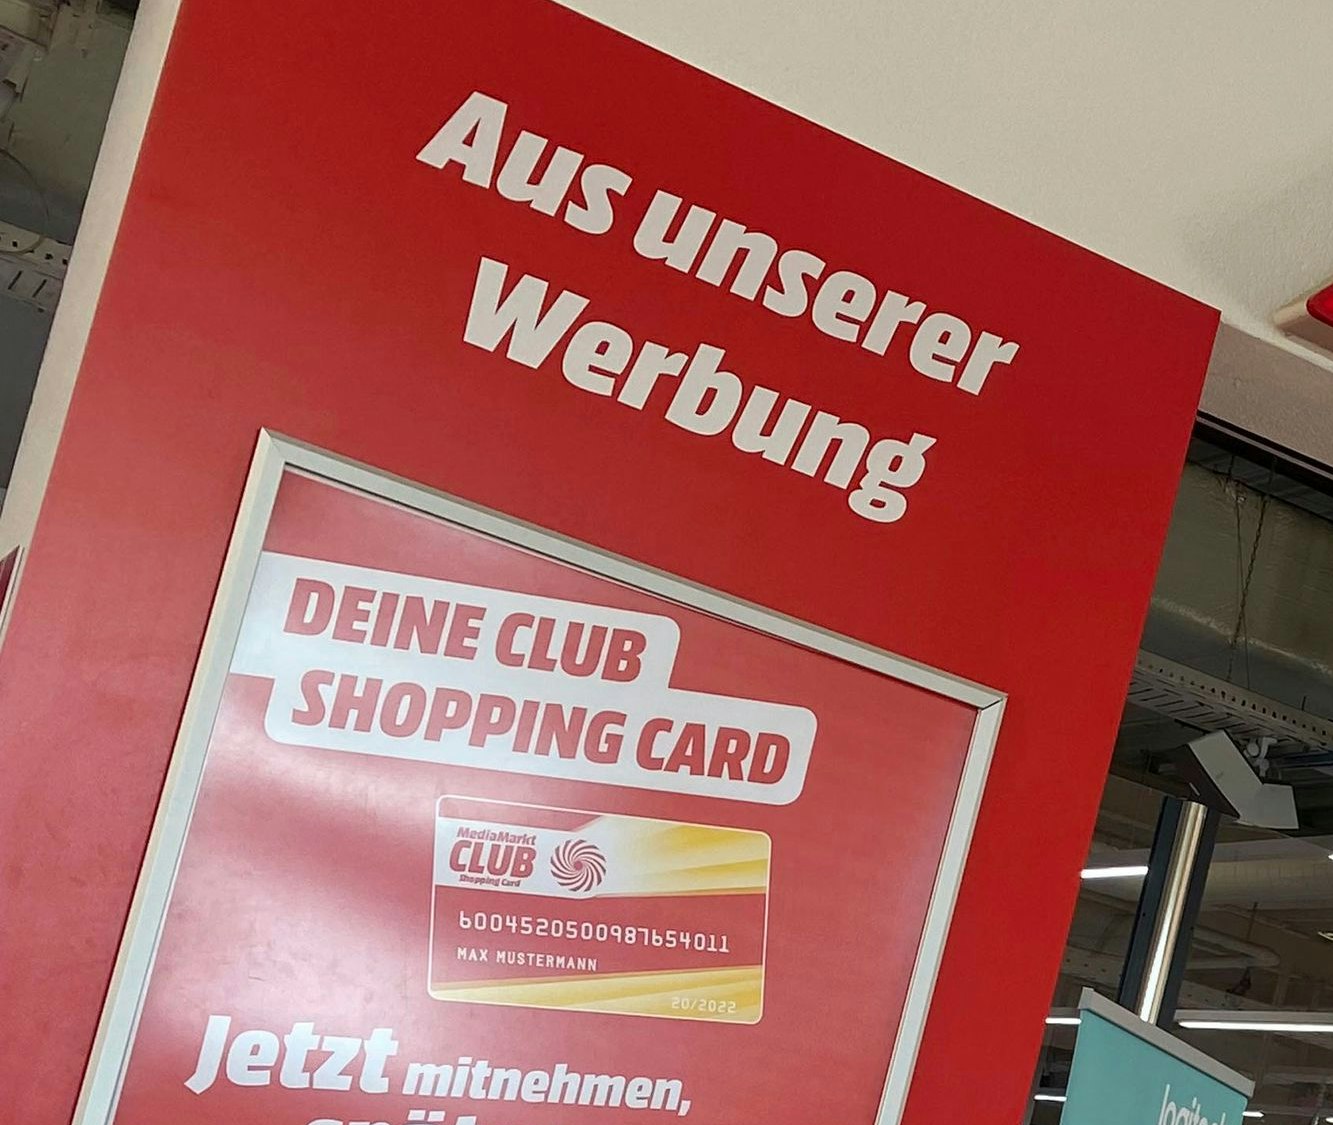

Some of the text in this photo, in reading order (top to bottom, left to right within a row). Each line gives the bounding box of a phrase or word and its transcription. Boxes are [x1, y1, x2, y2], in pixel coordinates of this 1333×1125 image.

[416, 91, 1019, 395] Aus unserer
[463, 256, 936, 522] Werbung
[283, 577, 647, 683] DEINE CLUB
[291, 670, 791, 785] SHOPPING CARD
[449, 840, 537, 878] CLUB
[457, 827, 536, 845] MediaMarkt
[459, 874, 520, 887] Shopping Card
[457, 947, 597, 971] MAX MUSTERMANN
[459, 910, 730, 953] 6004520500987654011
[184, 1014, 692, 1116] Jetzt mitnehmen,
